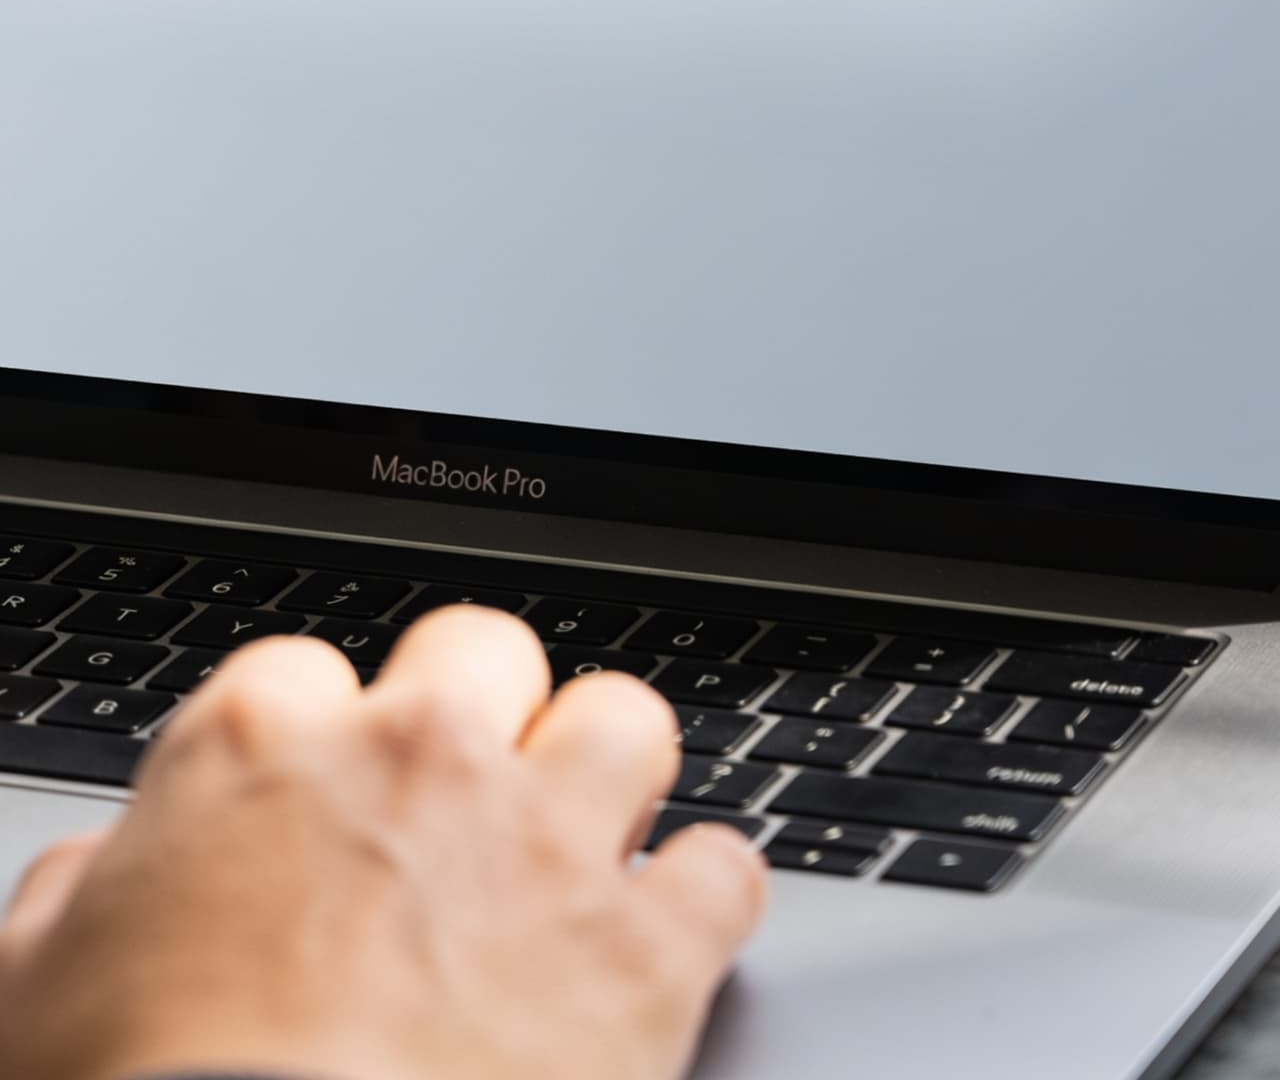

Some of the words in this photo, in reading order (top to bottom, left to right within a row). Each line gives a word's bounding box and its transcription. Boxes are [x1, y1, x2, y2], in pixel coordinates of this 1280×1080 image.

[372, 454, 497, 493] MacBook
[503, 469, 545, 498] Pro
[99, 569, 119, 580] 5
[212, 583, 231, 593] 6
[2, 596, 24, 607] R
[118, 609, 137, 620] T
[232, 622, 253, 633] Y
[555, 621, 577, 632] 9
[342, 635, 369, 648] U
[88, 652, 112, 664] G
[696, 675, 720, 687] P
[94, 701, 118, 714] B
